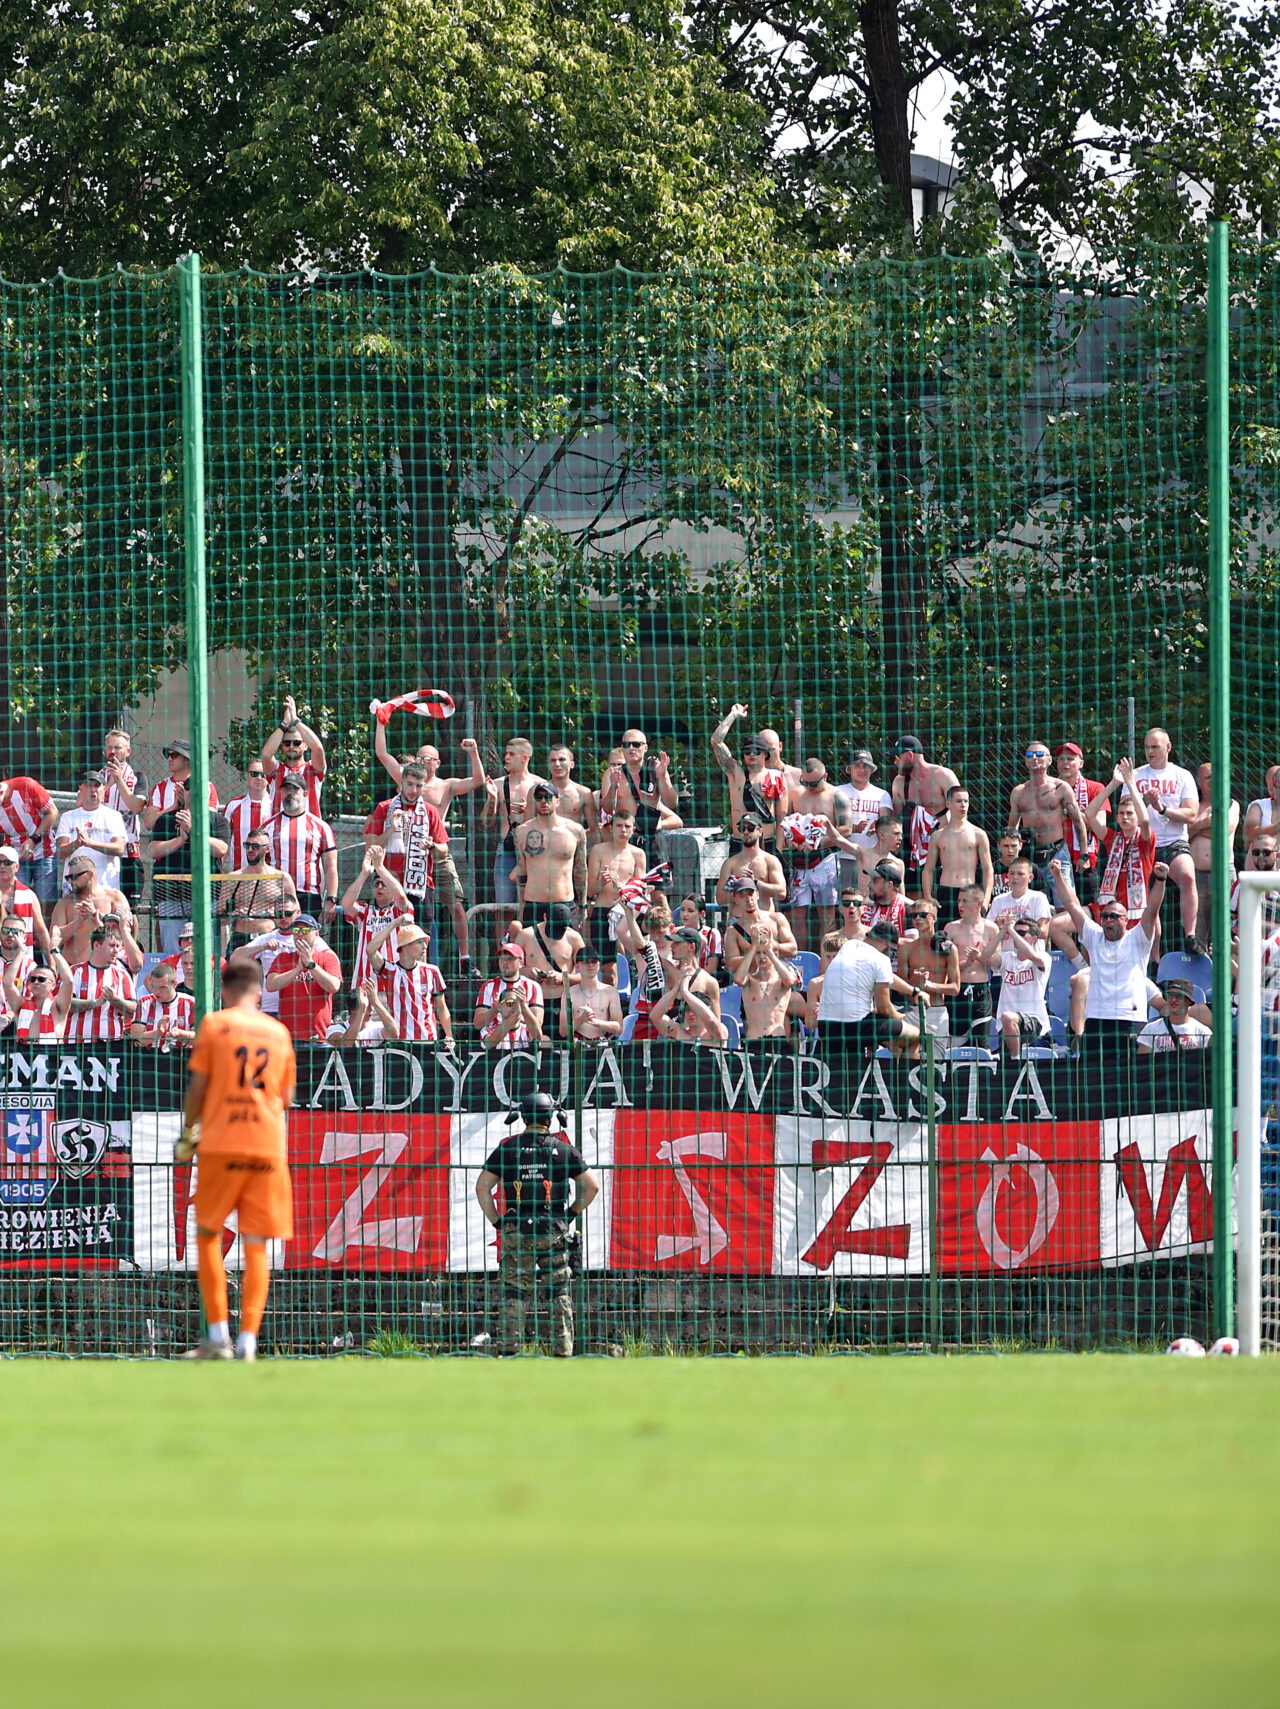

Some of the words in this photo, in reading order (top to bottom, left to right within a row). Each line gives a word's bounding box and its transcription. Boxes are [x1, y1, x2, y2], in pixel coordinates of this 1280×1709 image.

[236, 1045, 269, 1089] 12
[709, 1048, 1057, 1122] WRASTA
[0, 1183, 45, 1197] 1905
